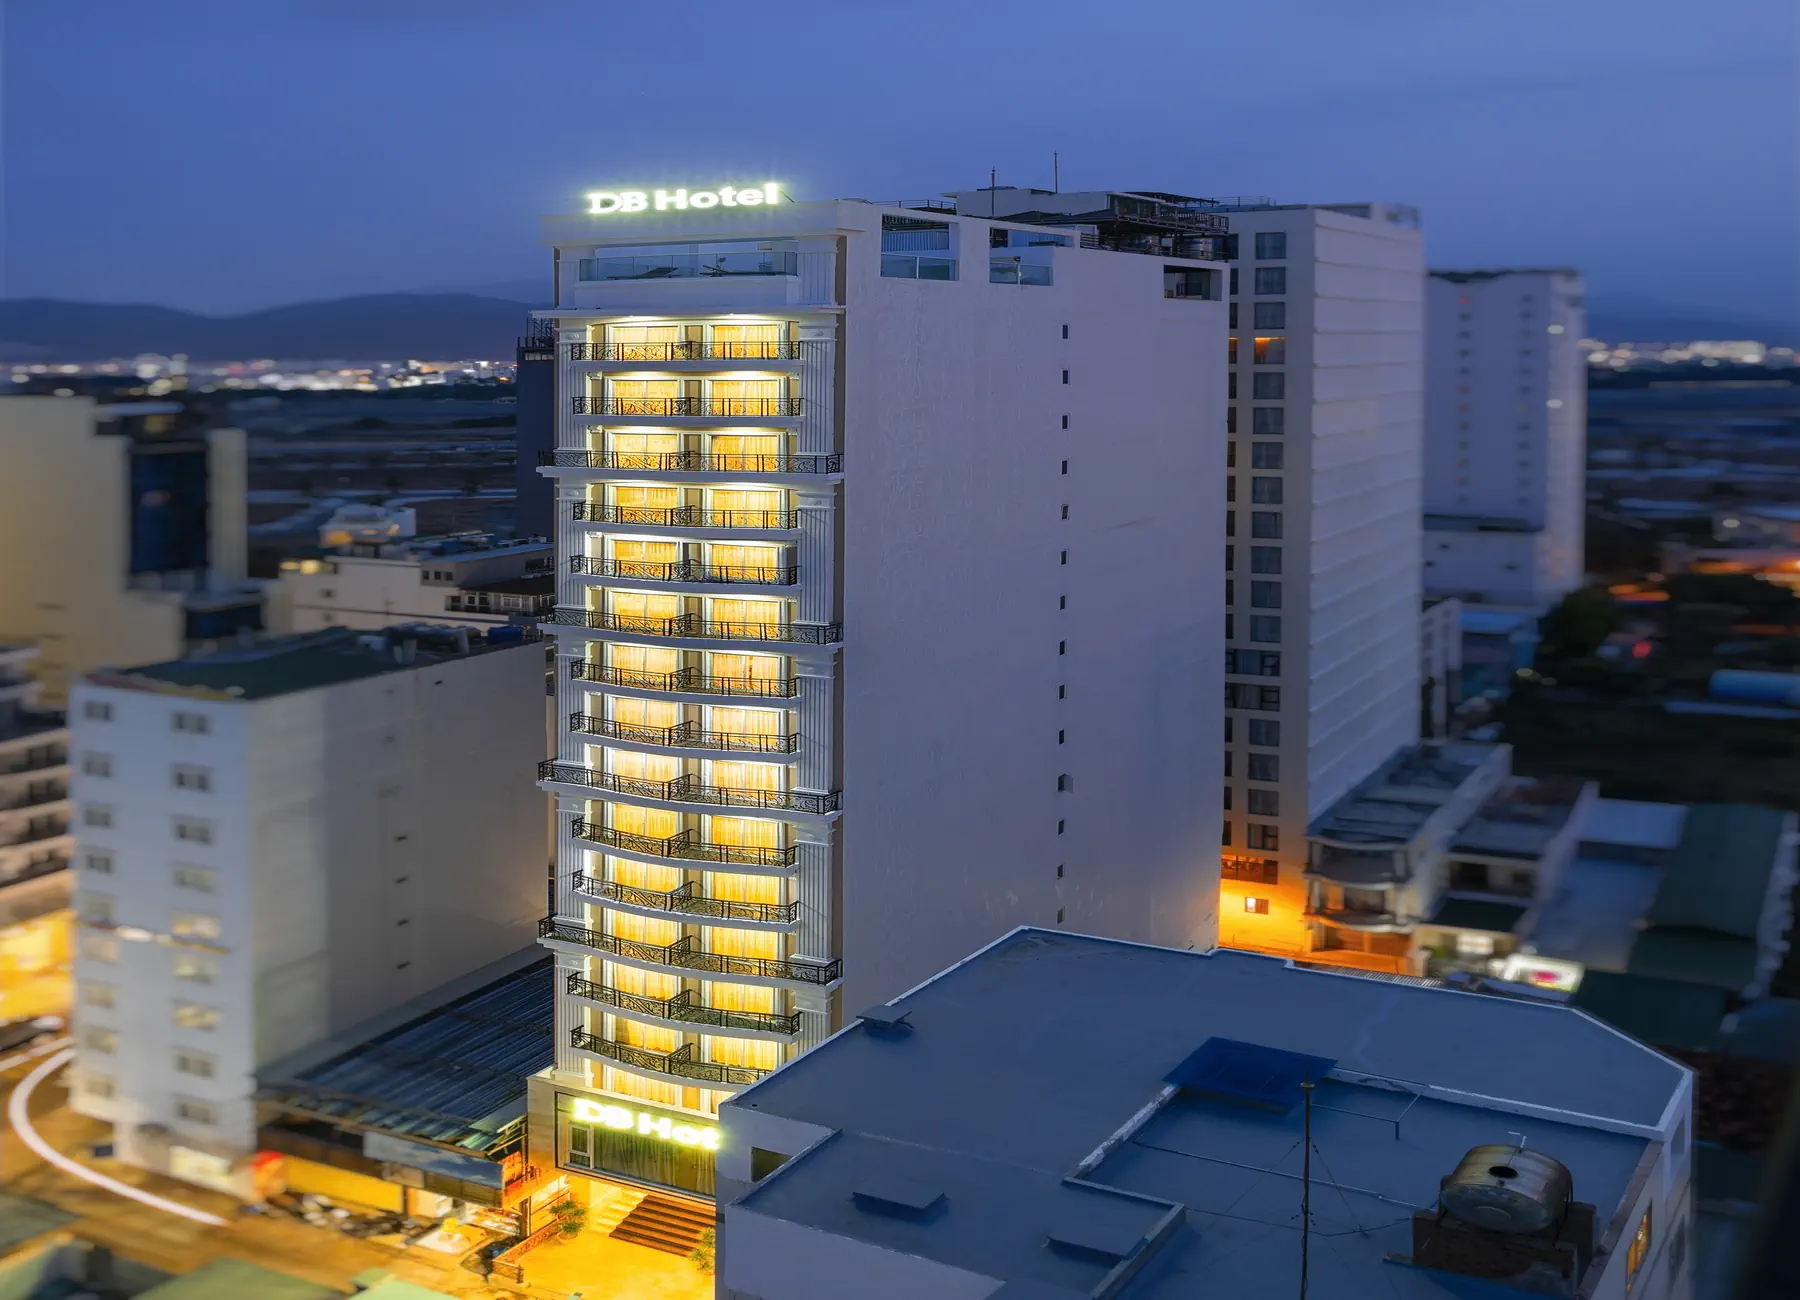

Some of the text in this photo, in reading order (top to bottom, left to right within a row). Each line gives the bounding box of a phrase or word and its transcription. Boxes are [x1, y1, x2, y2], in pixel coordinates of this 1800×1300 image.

[587, 182, 779, 214] DB Hotel
[573, 1098, 633, 1129] DB
